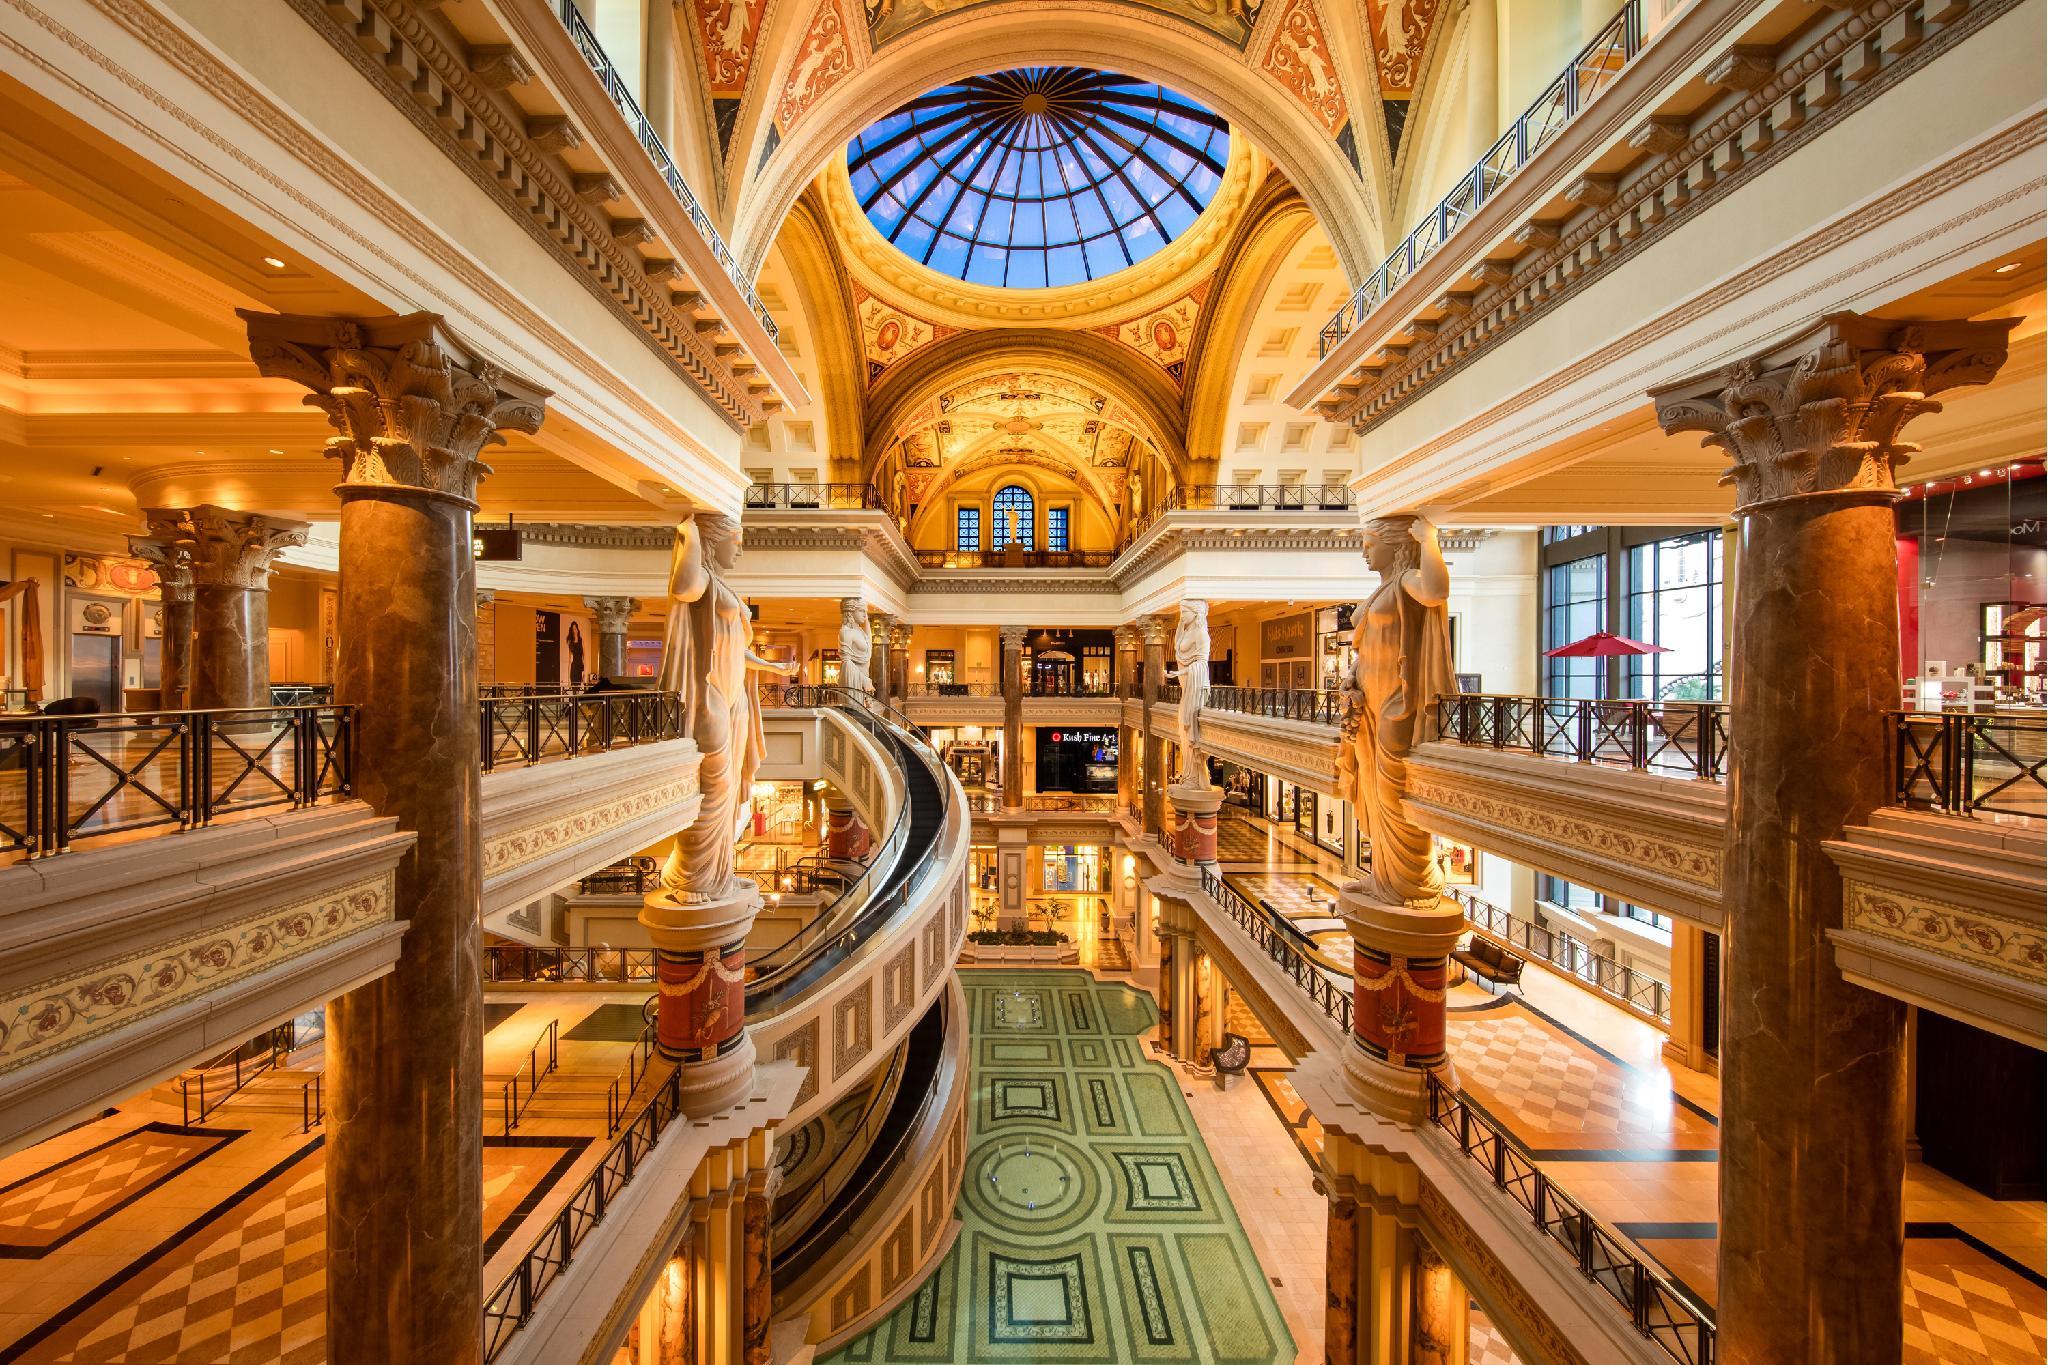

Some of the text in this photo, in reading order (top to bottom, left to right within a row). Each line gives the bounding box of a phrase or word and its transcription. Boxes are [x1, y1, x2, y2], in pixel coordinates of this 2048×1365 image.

[536, 623, 545, 632] EN
[1063, 731, 1116, 743] Kush Fine Art
